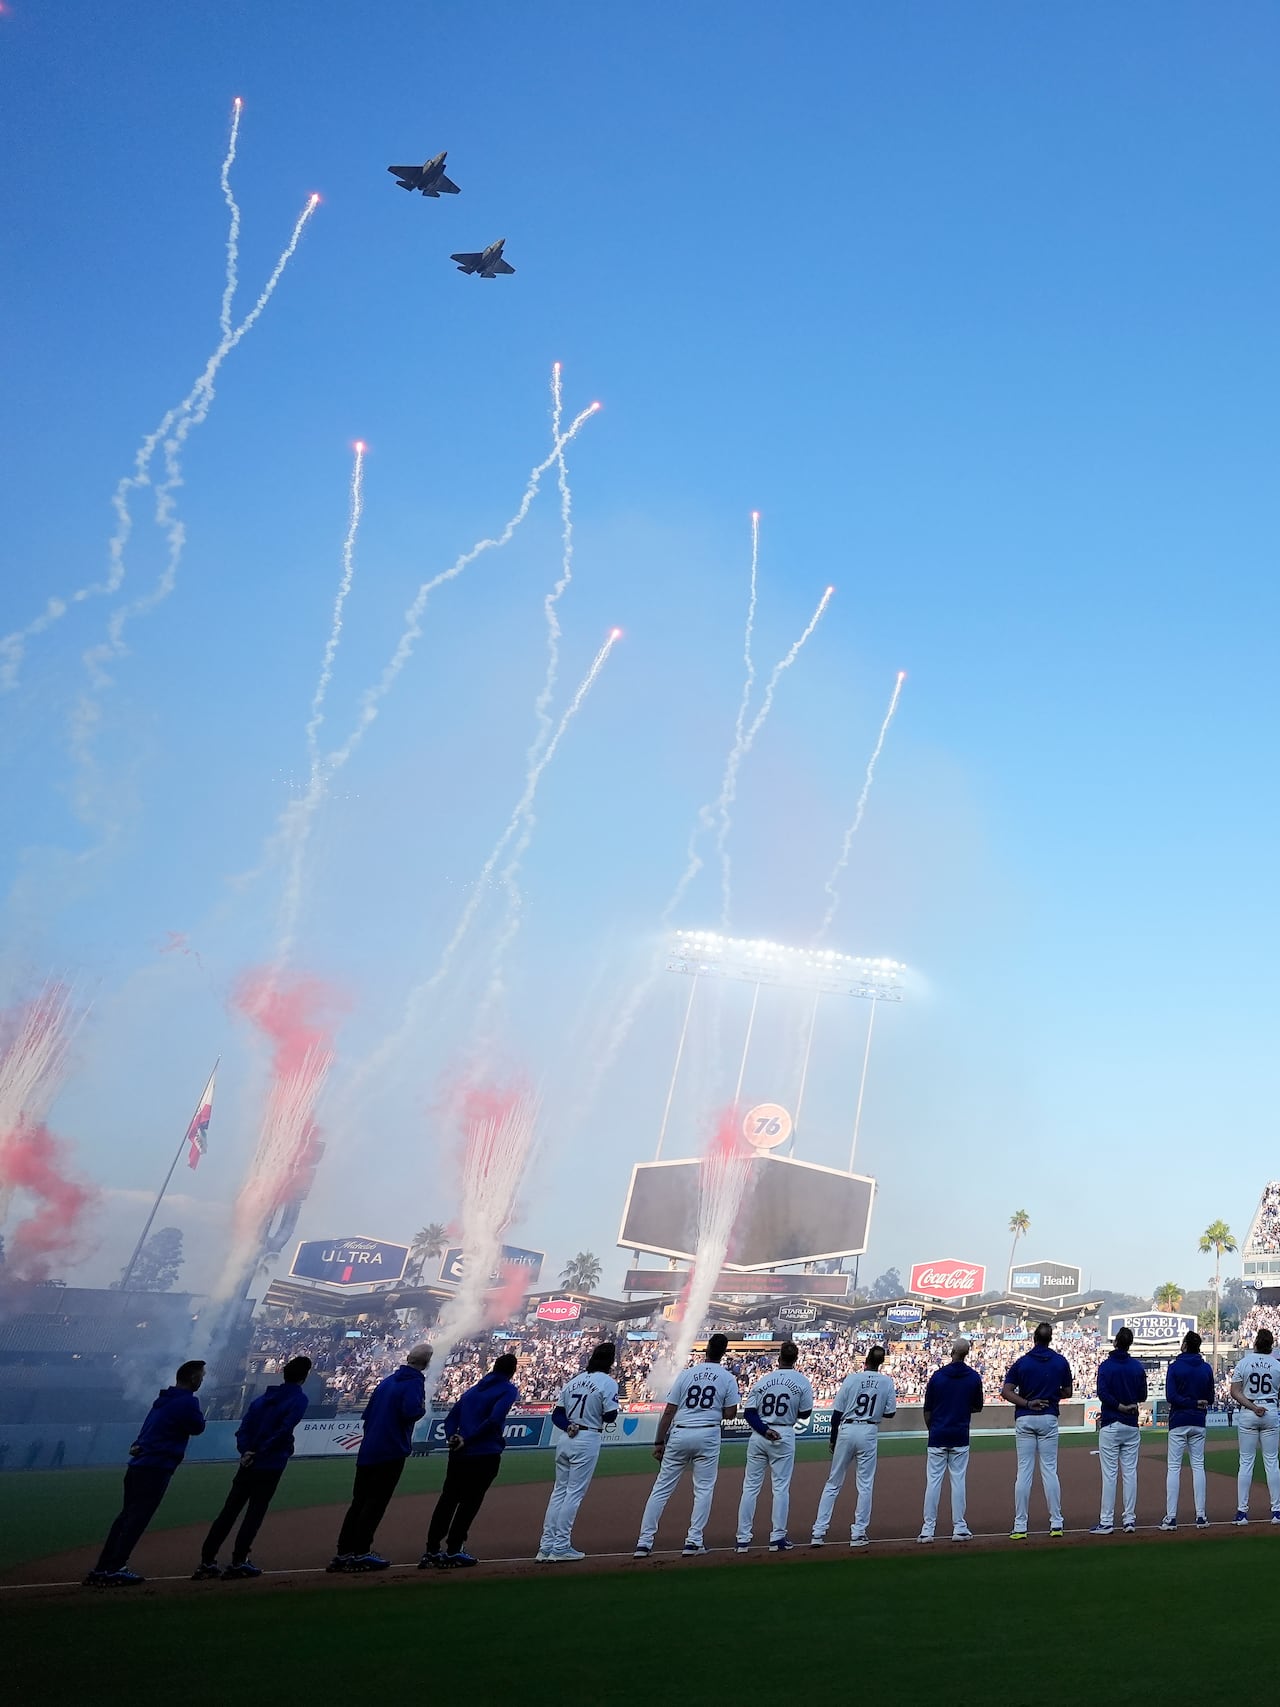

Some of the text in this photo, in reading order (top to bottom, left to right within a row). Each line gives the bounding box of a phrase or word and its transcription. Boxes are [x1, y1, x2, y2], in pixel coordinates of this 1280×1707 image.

[753, 1116, 781, 1136] 76
[321, 1250, 383, 1265] ULTRA
[917, 1268, 979, 1290] Coca-Cola
[1015, 1275, 1075, 1286] UCLA Health
[889, 1309, 921, 1317] MORTON
[693, 1371, 719, 1382] GEREN
[861, 1380, 879, 1390] EBEL
[1249, 1372, 1273, 1394] 96
[568, 1380, 600, 1394] LEHMANN
[685, 1384, 717, 1409] 88
[761, 1393, 791, 1417] 86
[854, 1393, 878, 1417] 91
[568, 1393, 588, 1419] 71
[304, 1423, 335, 1431] BANK
